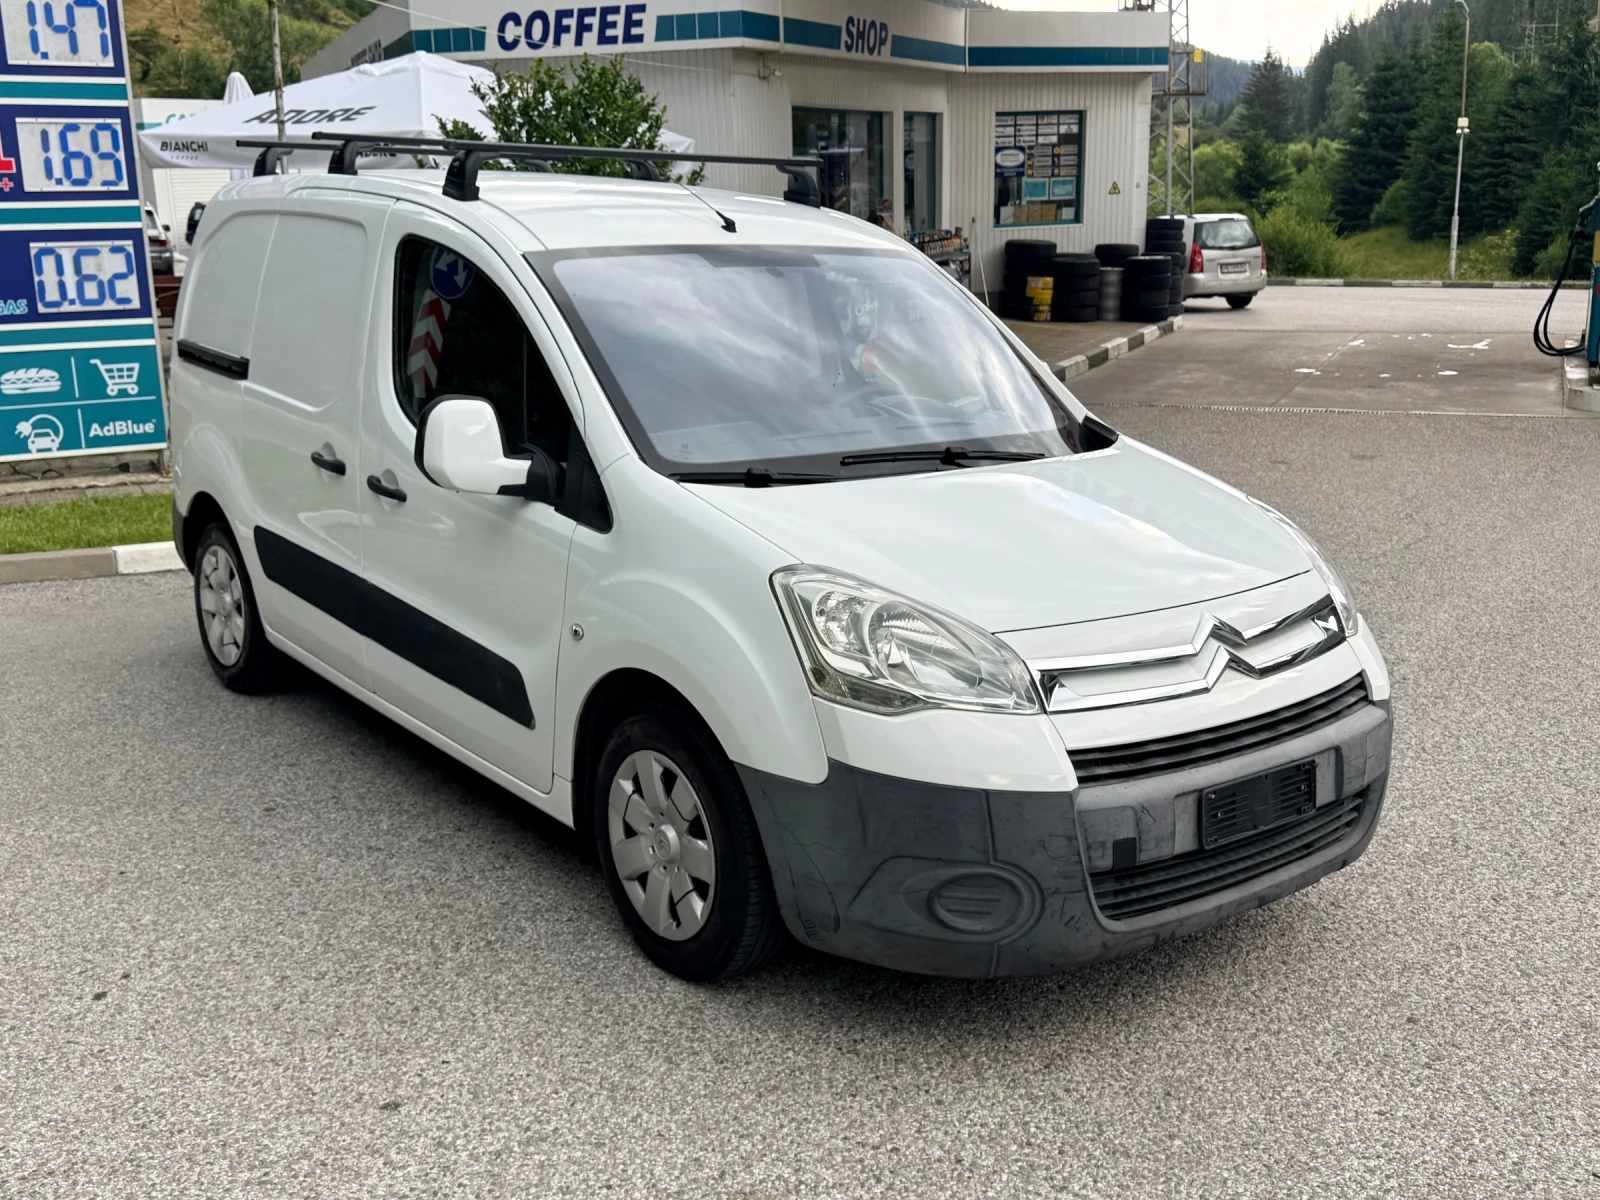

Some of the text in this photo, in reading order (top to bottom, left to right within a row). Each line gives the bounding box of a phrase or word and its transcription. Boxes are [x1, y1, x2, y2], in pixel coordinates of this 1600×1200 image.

[498, 4, 647, 51] COFFEE
[845, 16, 889, 56] SHOP
[242, 106, 377, 124] ADORE
[41, 123, 123, 187] 1.69
[160, 141, 208, 152] BIANCHI
[33, 246, 135, 309] 0.62
